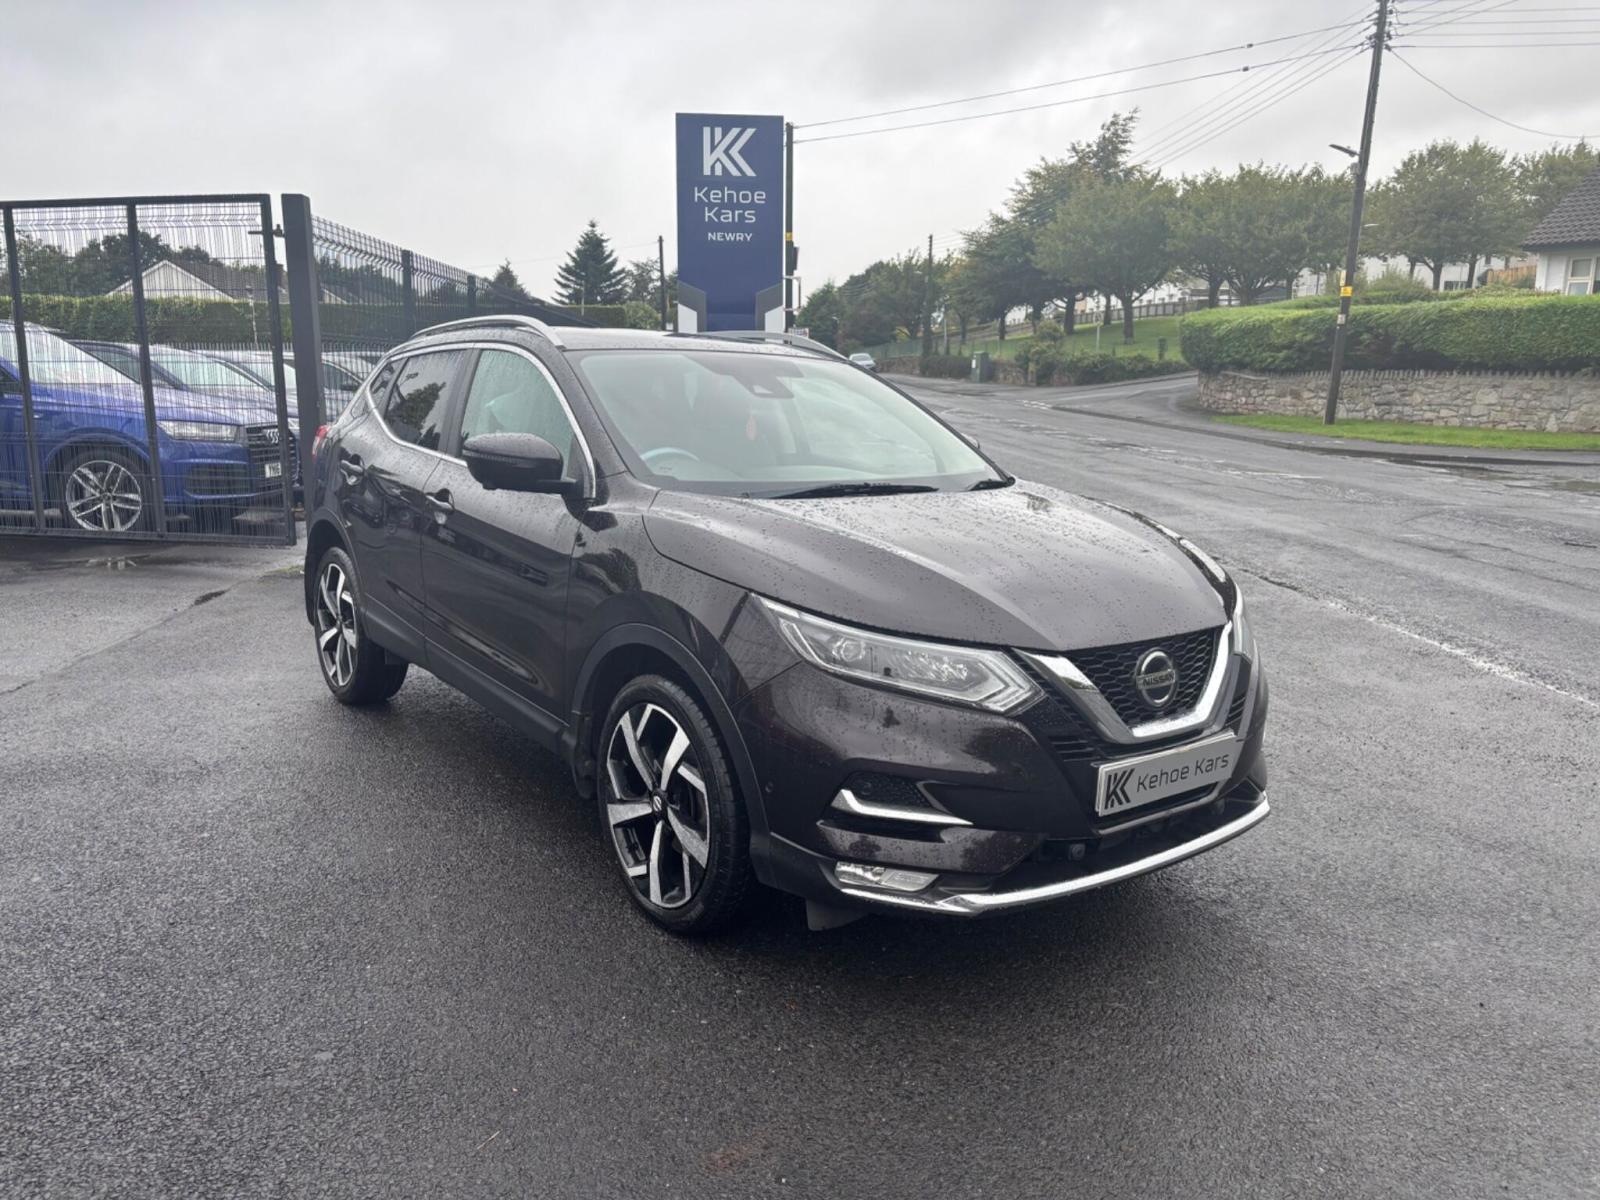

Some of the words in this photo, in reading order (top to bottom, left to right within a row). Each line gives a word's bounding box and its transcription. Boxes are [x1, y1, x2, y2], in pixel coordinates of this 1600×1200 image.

[694, 186, 766, 204] Kehoe
[704, 206, 756, 223] Kars
[707, 232, 753, 241] NEWRY
[1137, 765, 1189, 792] Kehoe
[1194, 754, 1229, 776] Kars
